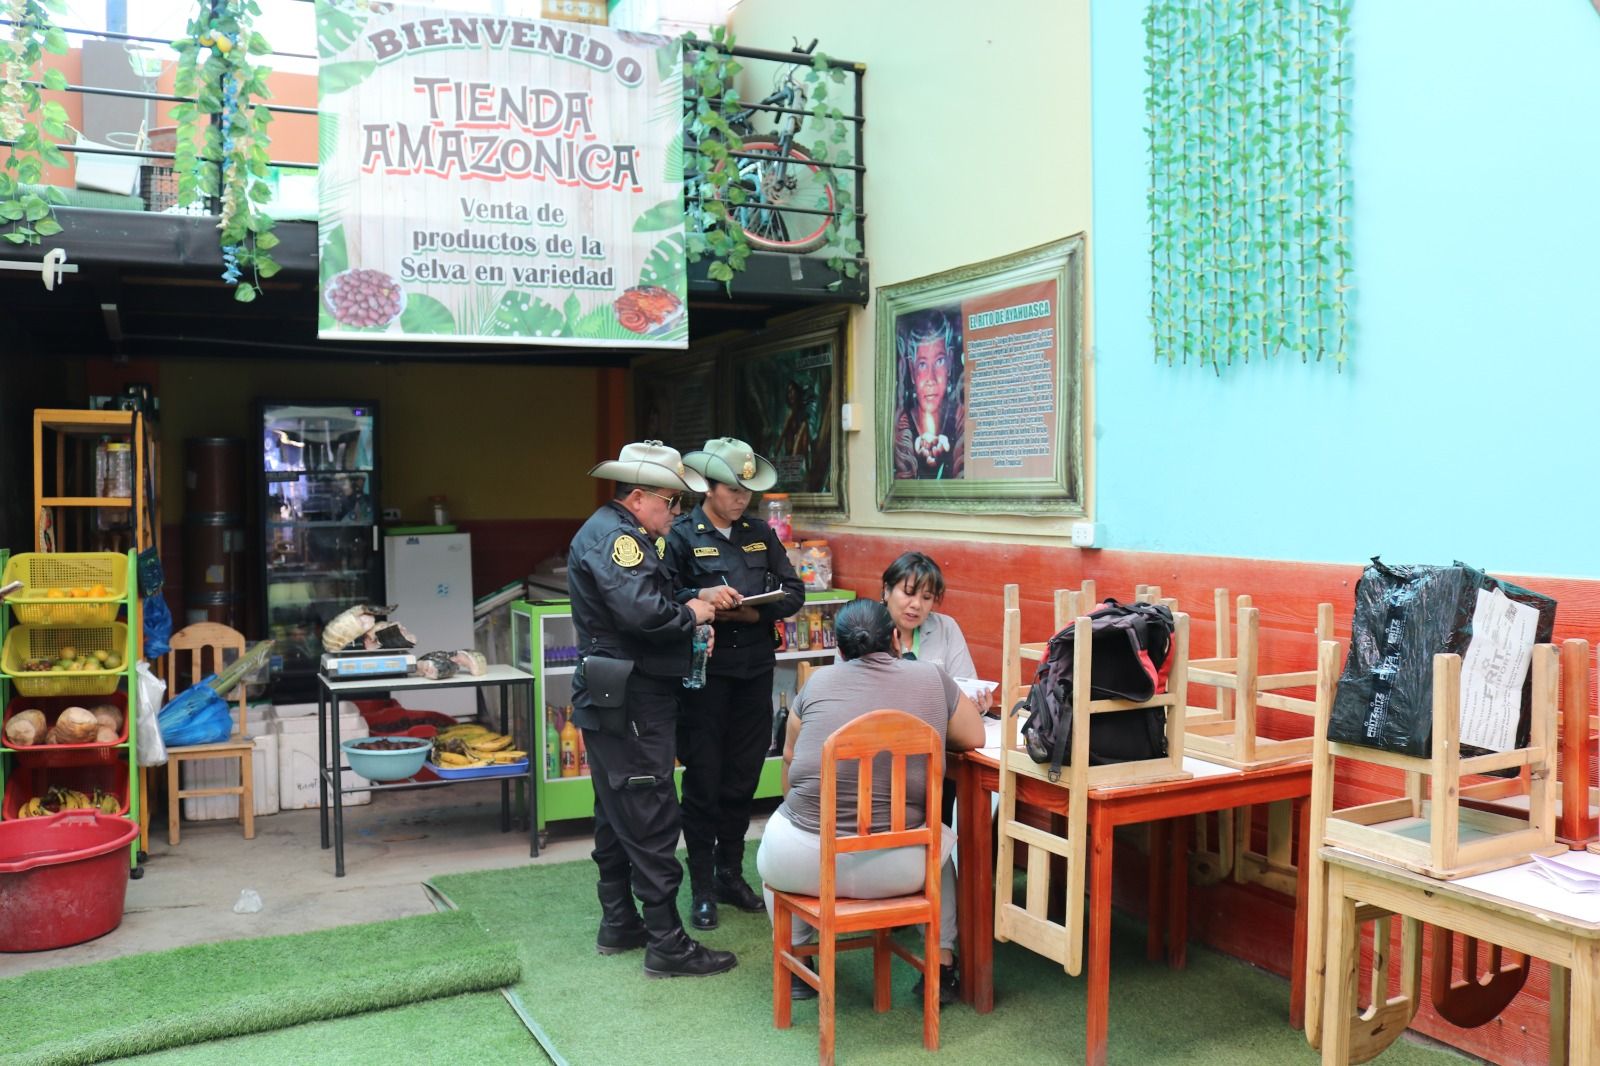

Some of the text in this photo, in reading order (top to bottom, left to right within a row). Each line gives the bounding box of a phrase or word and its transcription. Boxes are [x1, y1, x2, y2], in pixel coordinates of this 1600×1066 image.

[368, 18, 643, 83] BIENVENIDO
[414, 76, 595, 137] TIENDA
[362, 121, 641, 189] AMAZONICA
[460, 197, 564, 223] Venta de
[413, 229, 602, 256] productos de la
[401, 258, 613, 286] Selva en variedad
[970, 316, 977, 328] EL
[995, 311, 1004, 323] DE
[1005, 302, 1050, 321] AYAHUASCA
